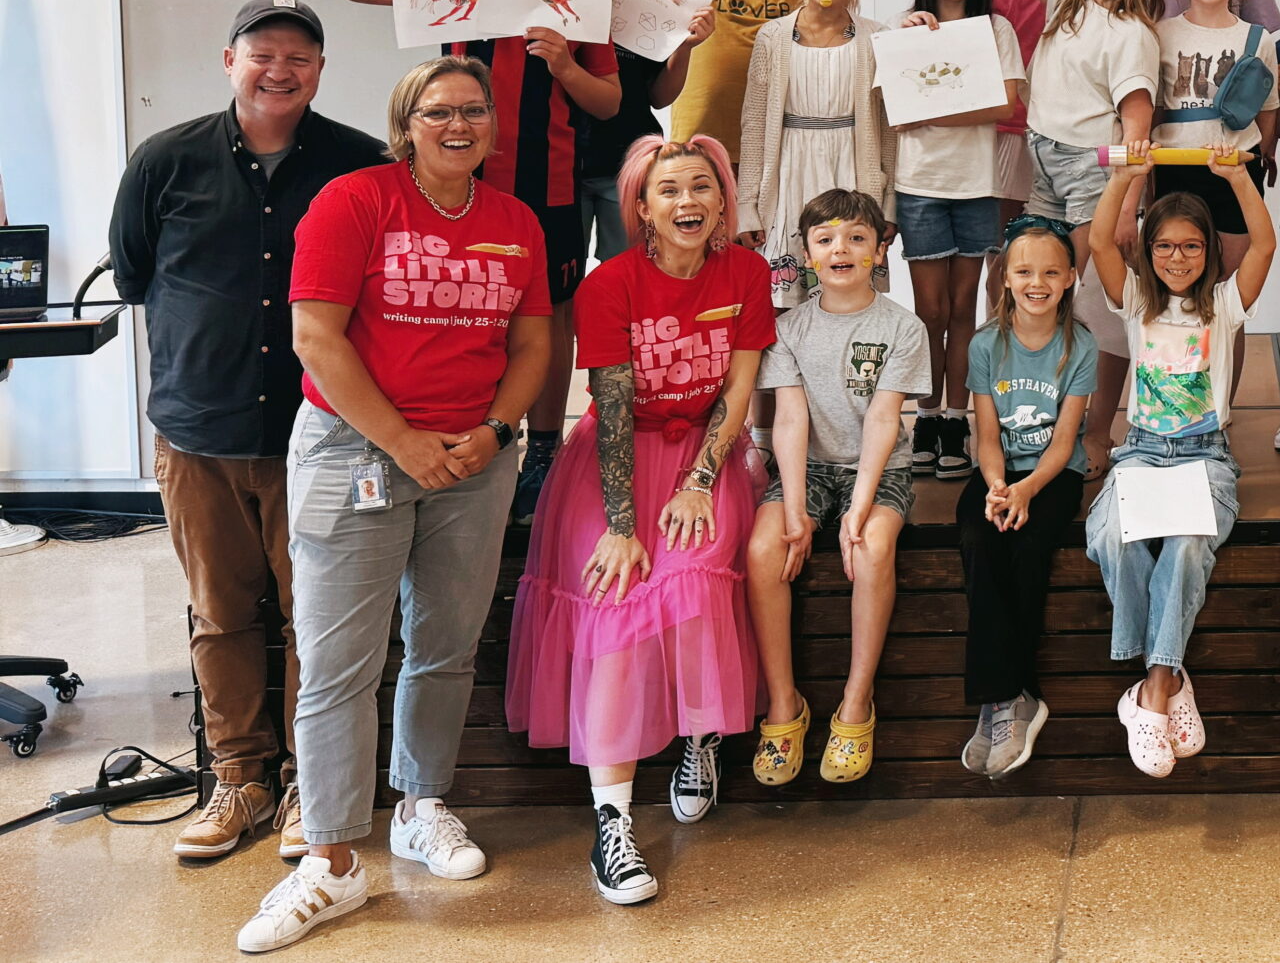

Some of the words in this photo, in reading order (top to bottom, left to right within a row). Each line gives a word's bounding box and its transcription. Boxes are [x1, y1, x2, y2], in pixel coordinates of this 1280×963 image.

[383, 312, 421, 325] writing
[423, 316, 449, 326] camp
[453, 315, 473, 328] july
[658, 390, 684, 401] camp
